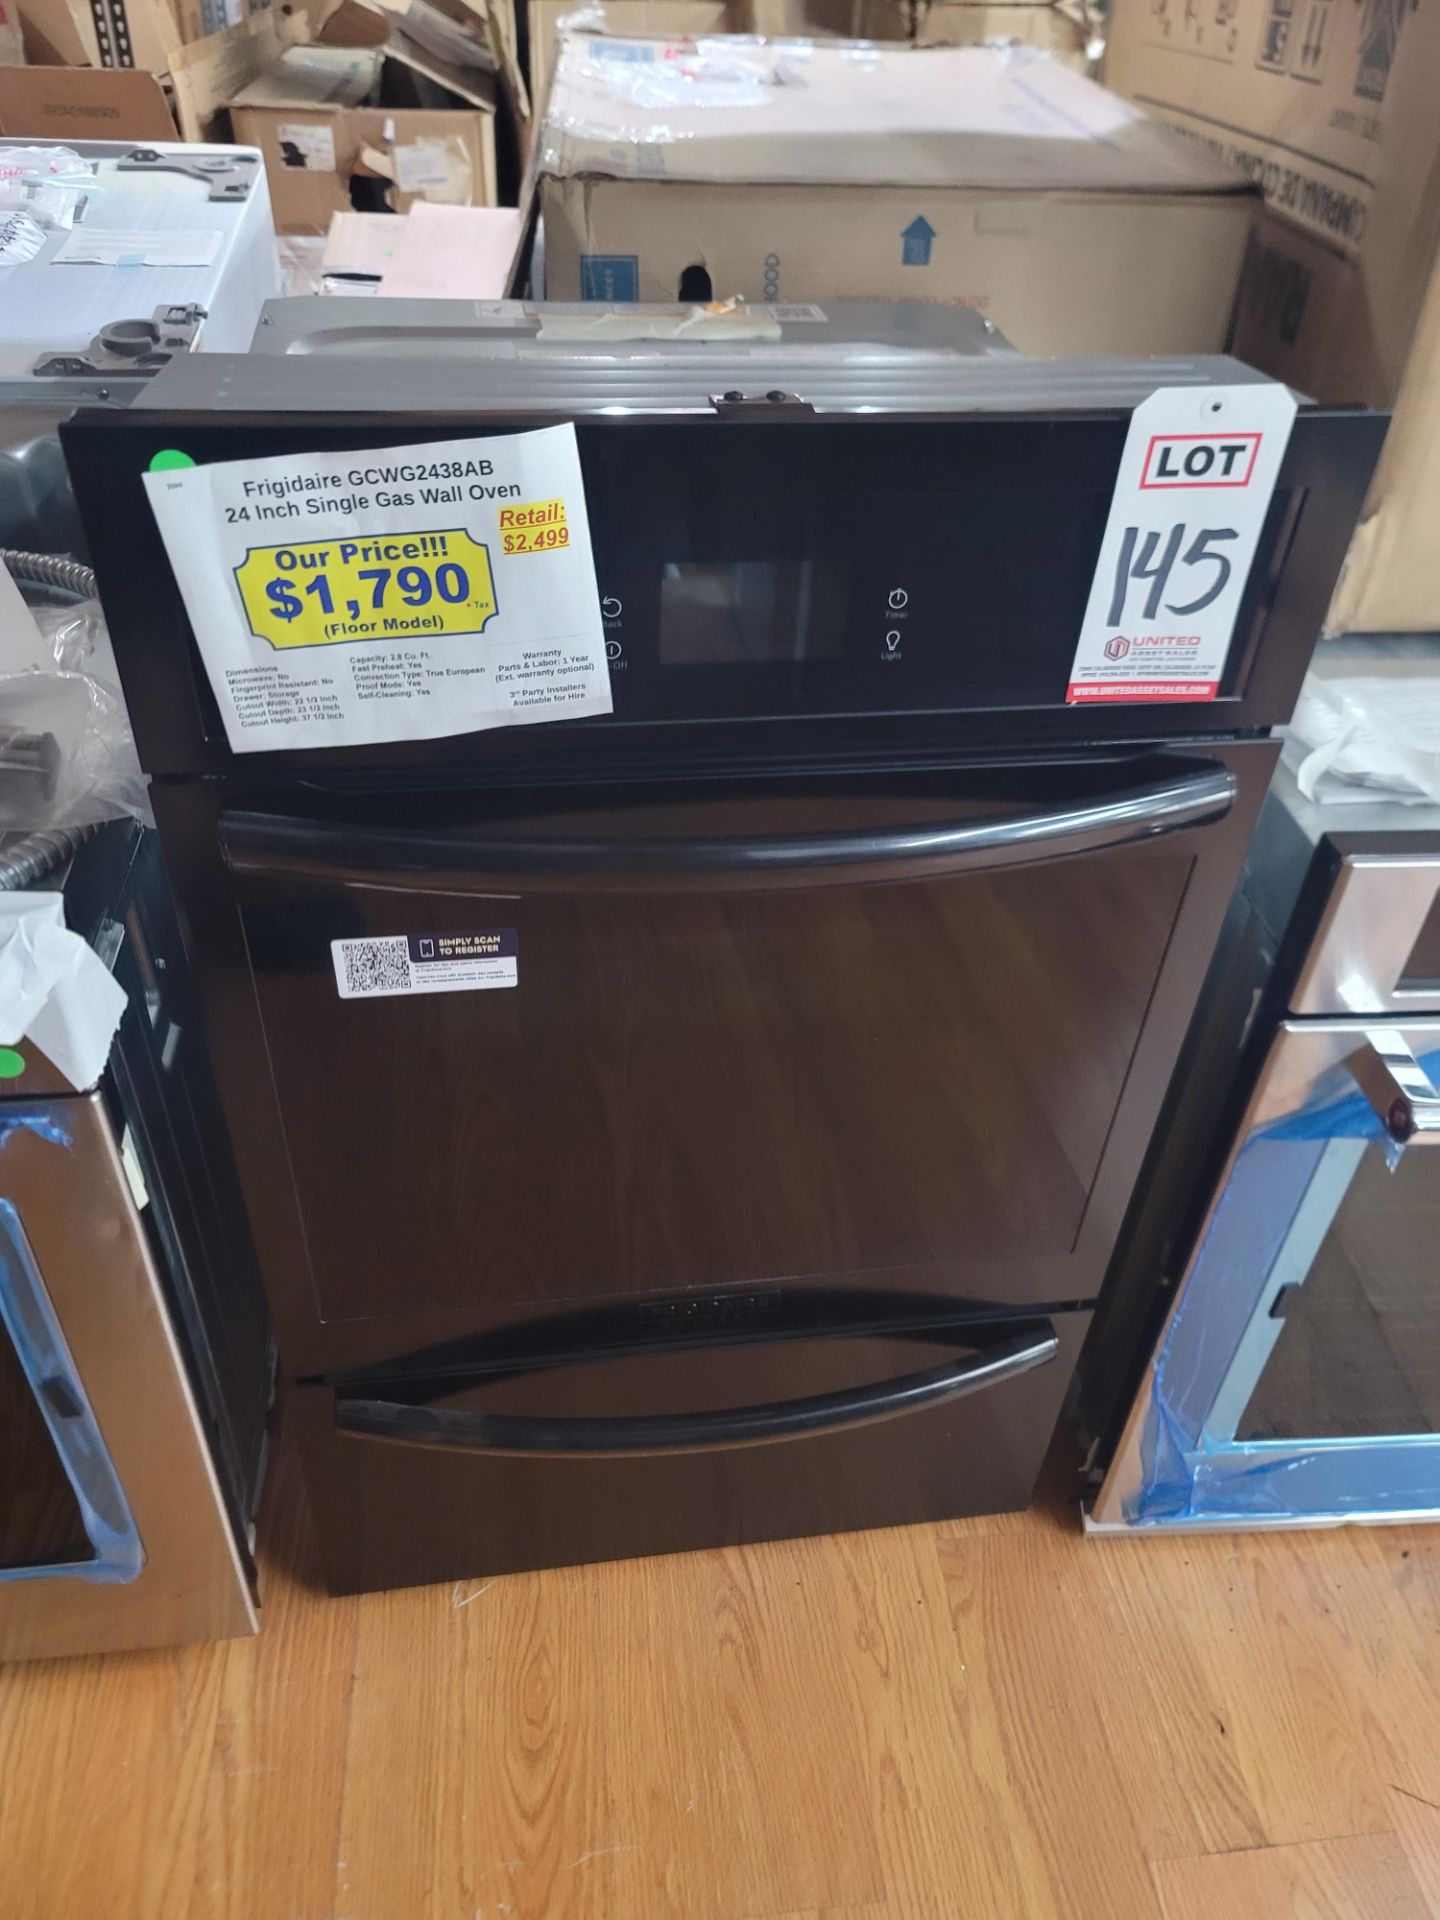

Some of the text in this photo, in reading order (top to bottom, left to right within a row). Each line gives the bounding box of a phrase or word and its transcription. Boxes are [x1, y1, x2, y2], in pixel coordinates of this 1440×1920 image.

[1155, 445, 1247, 477] LOT
[243, 459, 494, 498] Frigidaire GCWG2438AB
[225, 484, 521, 523] 24 Inch Single Gas Wall Oven
[499, 503, 565, 528] Retail:
[503, 527, 569, 554] $2,499
[274, 536, 449, 571] Our Price!!!
[1106, 523, 1240, 627] 145
[265, 563, 470, 623] $1,790
[473, 601, 489, 609] Tax
[324, 615, 444, 638] (Floor Model)
[1133, 636, 1201, 646] UNITED
[349, 655, 388, 665] Capacity:
[404, 652, 417, 660] Cu.
[420, 651, 431, 659] Ft.
[522, 648, 562, 660] Warranty
[881, 652, 901, 661] Light
[225, 665, 279, 677] Dimensions
[371, 663, 405, 671] Preheat:
[498, 664, 521, 672] Parts
[532, 658, 561, 668] Labor:
[569, 655, 589, 663] Year
[228, 673, 289, 686] Microwave: No
[354, 672, 400, 681] Convection
[402, 671, 424, 680] Type:
[446, 667, 485, 677] European
[495, 662, 595, 683] (Ext. warranty optional)
[231, 682, 277, 694] Fingerprint
[278, 679, 320, 690] Resistant:
[356, 682, 379, 691] Proof
[380, 681, 405, 689] Mode:
[522, 688, 545, 698] Party
[546, 683, 587, 694] Installers
[233, 690, 300, 703] Drawer: Storage
[358, 688, 431, 700] Self-Cleaning: Yes
[513, 692, 586, 707] Available for Hire
[236, 701, 265, 711] Cutout
[266, 698, 291, 708] Width:
[306, 696, 318, 704] 1/2
[319, 695, 338, 703] Inch
[238, 710, 267, 720] Cutout
[268, 706, 294, 717] Depth:
[322, 703, 340, 711] Inch
[241, 711, 345, 728] Cutout Height: 37 1/2 Inch
[438, 935, 501, 947] SIMPLY SCAN
[439, 944, 499, 956] TO REGISTER
